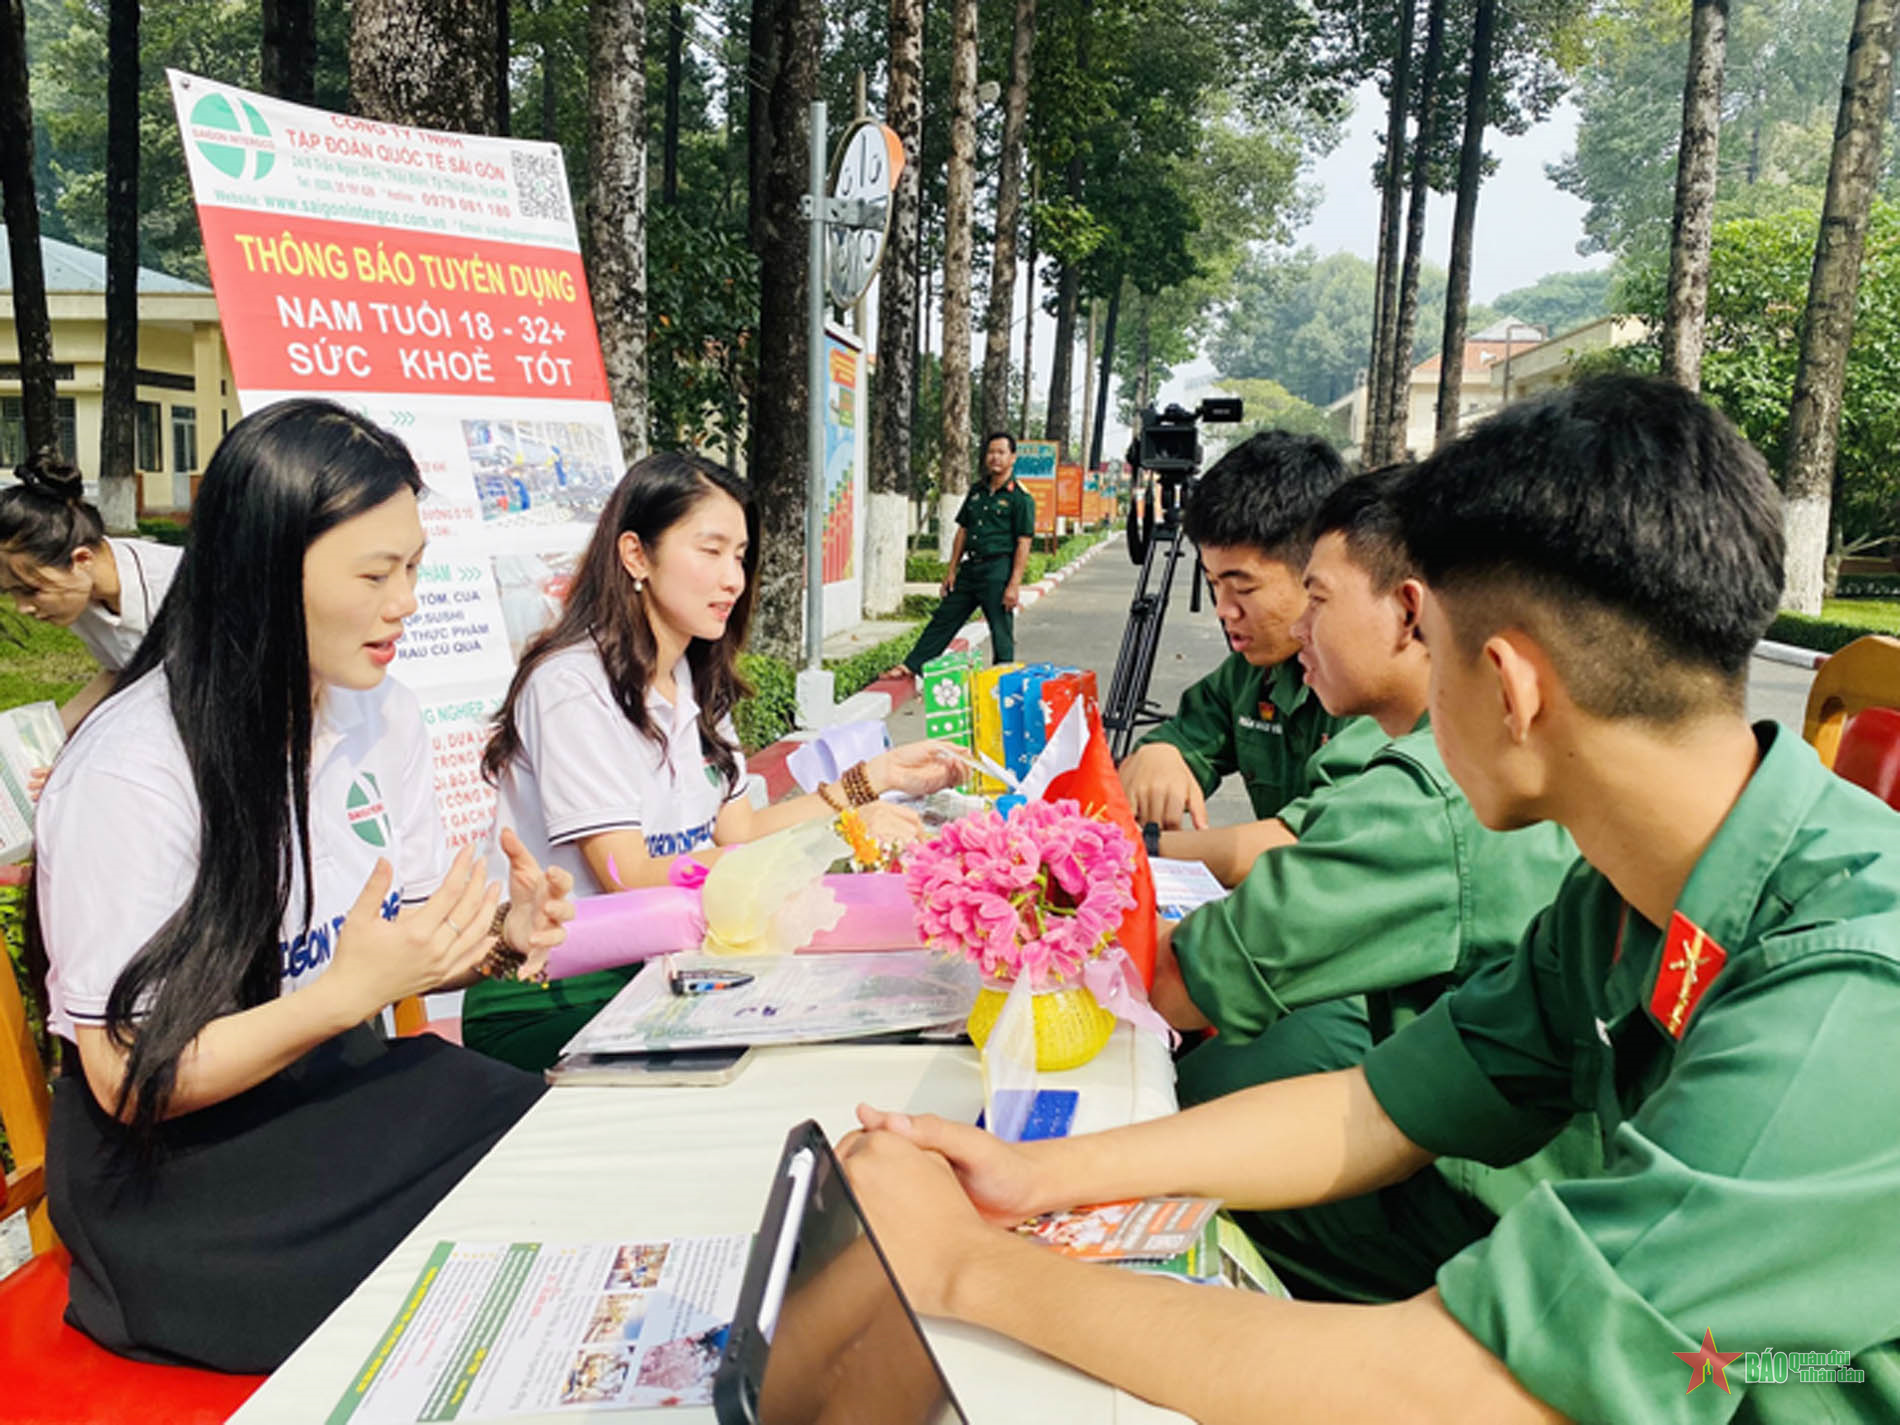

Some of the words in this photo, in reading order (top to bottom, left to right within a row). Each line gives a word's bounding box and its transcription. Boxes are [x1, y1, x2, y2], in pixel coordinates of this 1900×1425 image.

[234, 230, 349, 280] THÔNG
[352, 241, 416, 287] BÁO
[418, 251, 507, 295] TUYỂN
[508, 264, 577, 307] DỤNG
[276, 295, 363, 333] NAM
[368, 299, 452, 338] TUỔI
[459, 310, 494, 342] 18
[517, 314, 567, 345] 32+
[287, 336, 372, 378] SỨC
[399, 346, 495, 383] KHOẺ
[515, 350, 573, 387] TỐT
